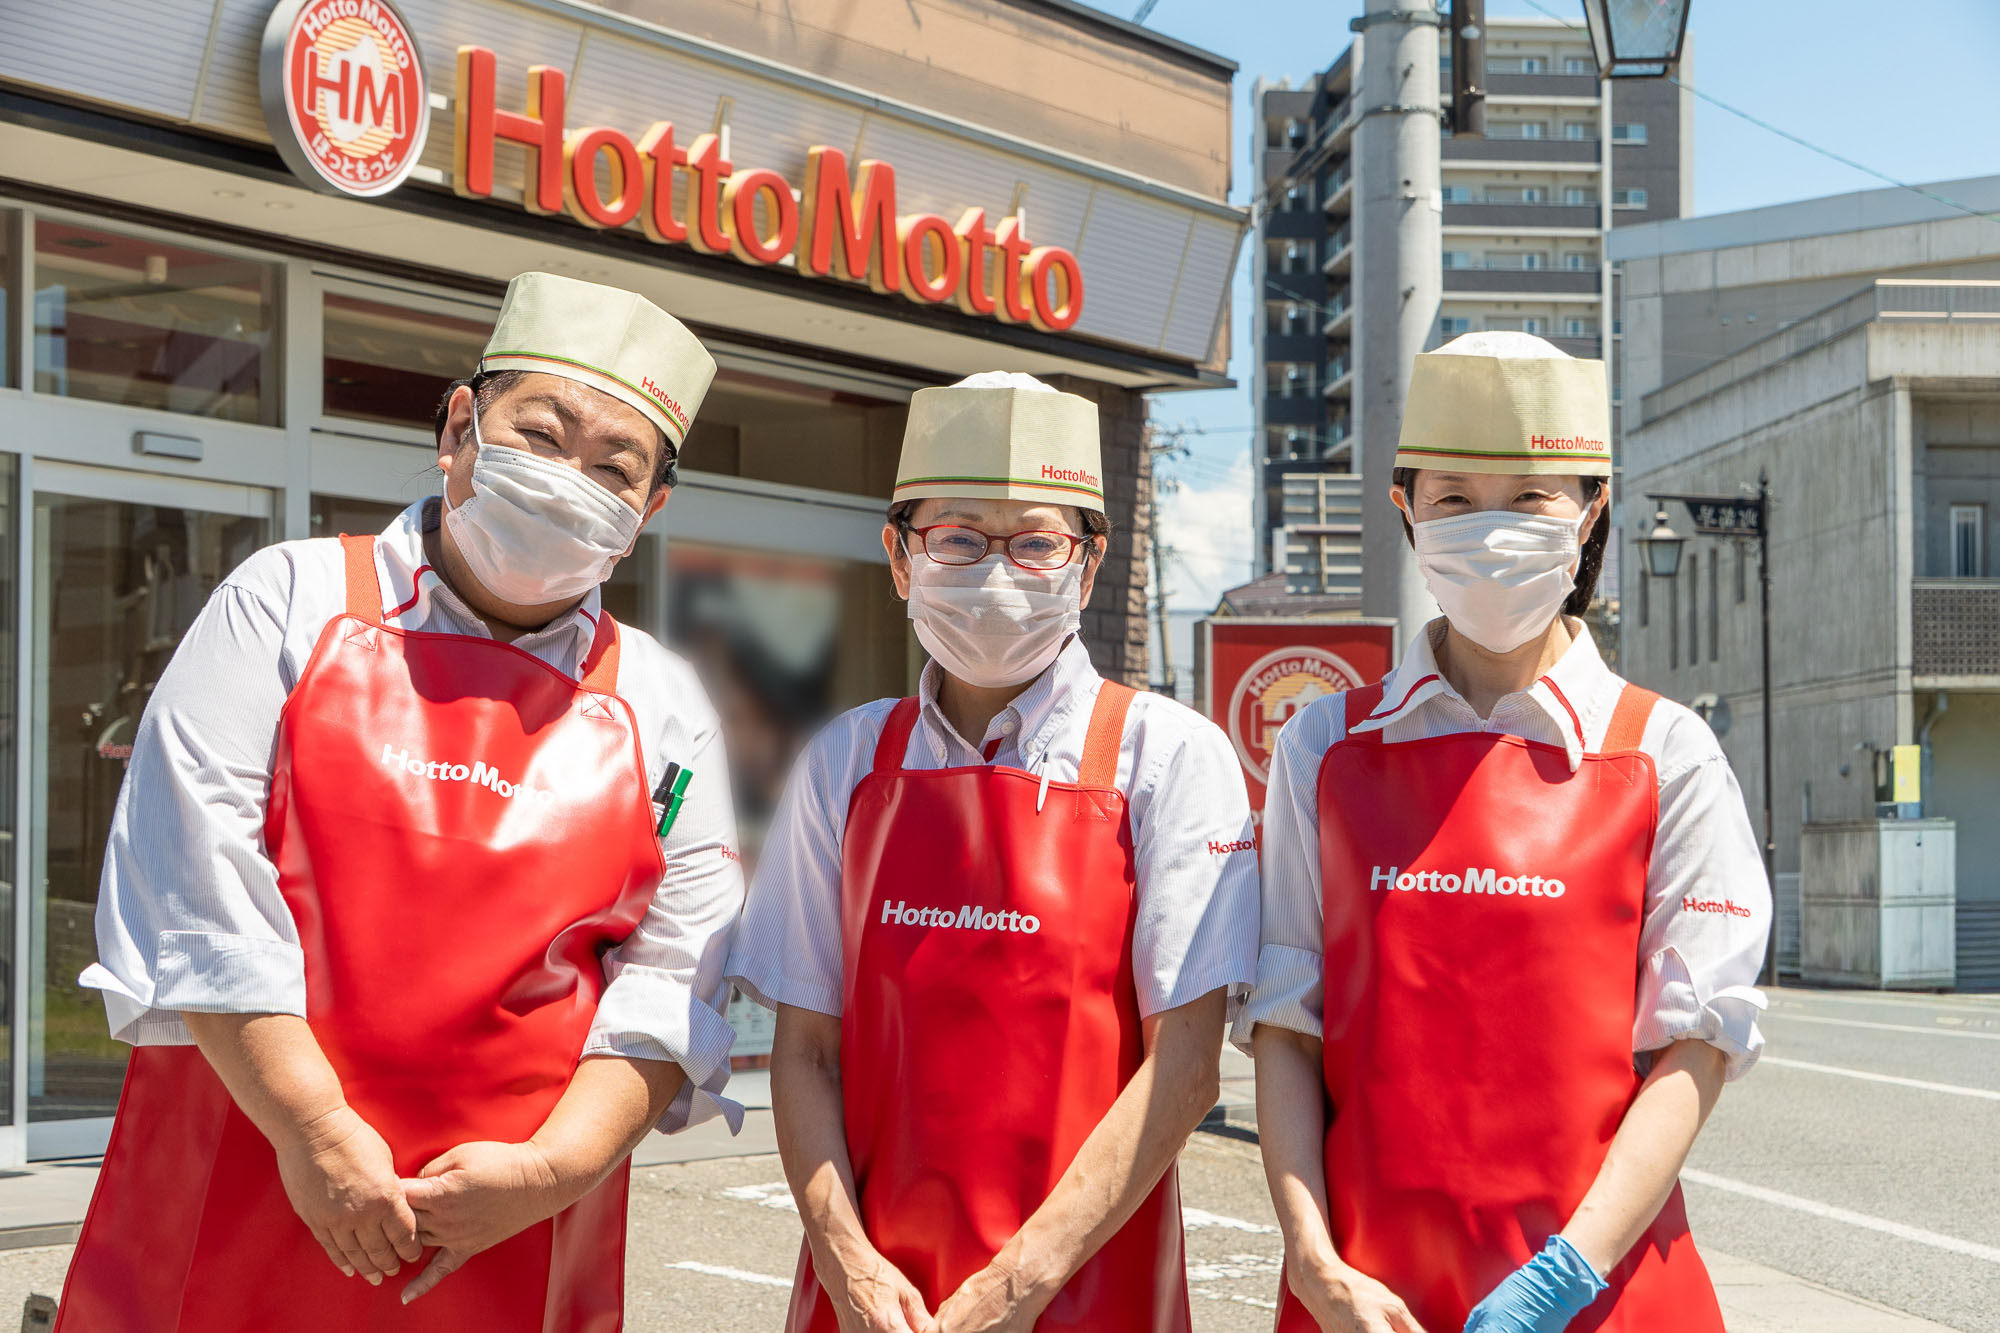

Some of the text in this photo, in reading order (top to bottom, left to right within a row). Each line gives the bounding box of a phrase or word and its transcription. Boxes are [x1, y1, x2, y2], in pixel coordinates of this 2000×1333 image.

[302, 0, 409, 69] HottoMotto
[307, 50, 401, 138] HM
[312, 132, 397, 182] ほっともっと
[455, 43, 1084, 333] HottoMotto
[1531, 434, 1604, 451] HottoMotto
[1041, 464, 1099, 488] HottoMotto
[1370, 866, 1566, 898] HottoMotto
[881, 900, 1041, 934] HottoMotto
